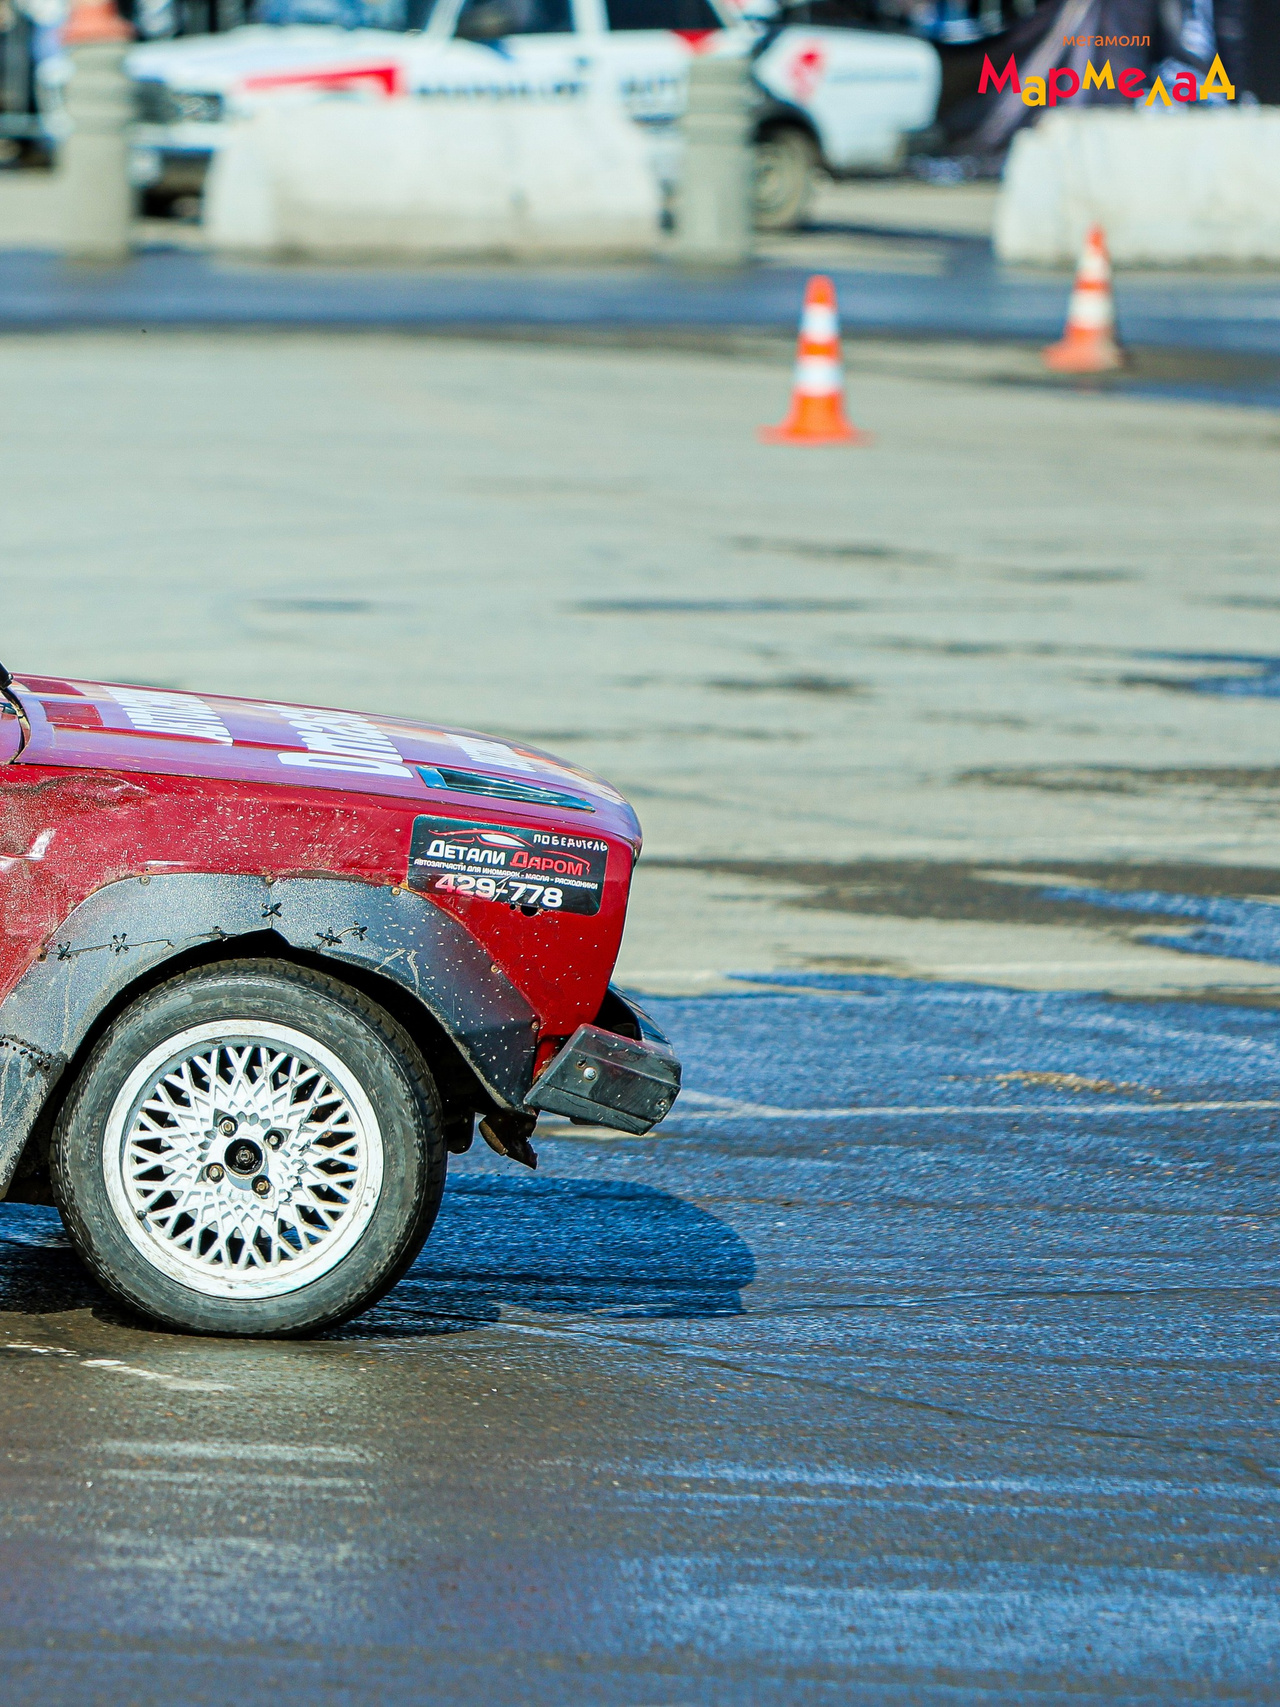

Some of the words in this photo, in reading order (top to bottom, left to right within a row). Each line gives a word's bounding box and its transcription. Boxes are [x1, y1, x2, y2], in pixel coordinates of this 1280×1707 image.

[413, 858, 466, 872] АВТОЗАПЧАСТИ
[466, 866, 482, 875] ДЛЯ
[481, 866, 521, 880] ИНОМАРОК
[525, 873, 550, 884] МАСЛА
[554, 877, 599, 890] РАСХОДНИКИ
[426, 839, 505, 865] ДЕТАЛИ
[509, 850, 583, 877] ДАРОМ
[434, 874, 563, 908] 429-778
